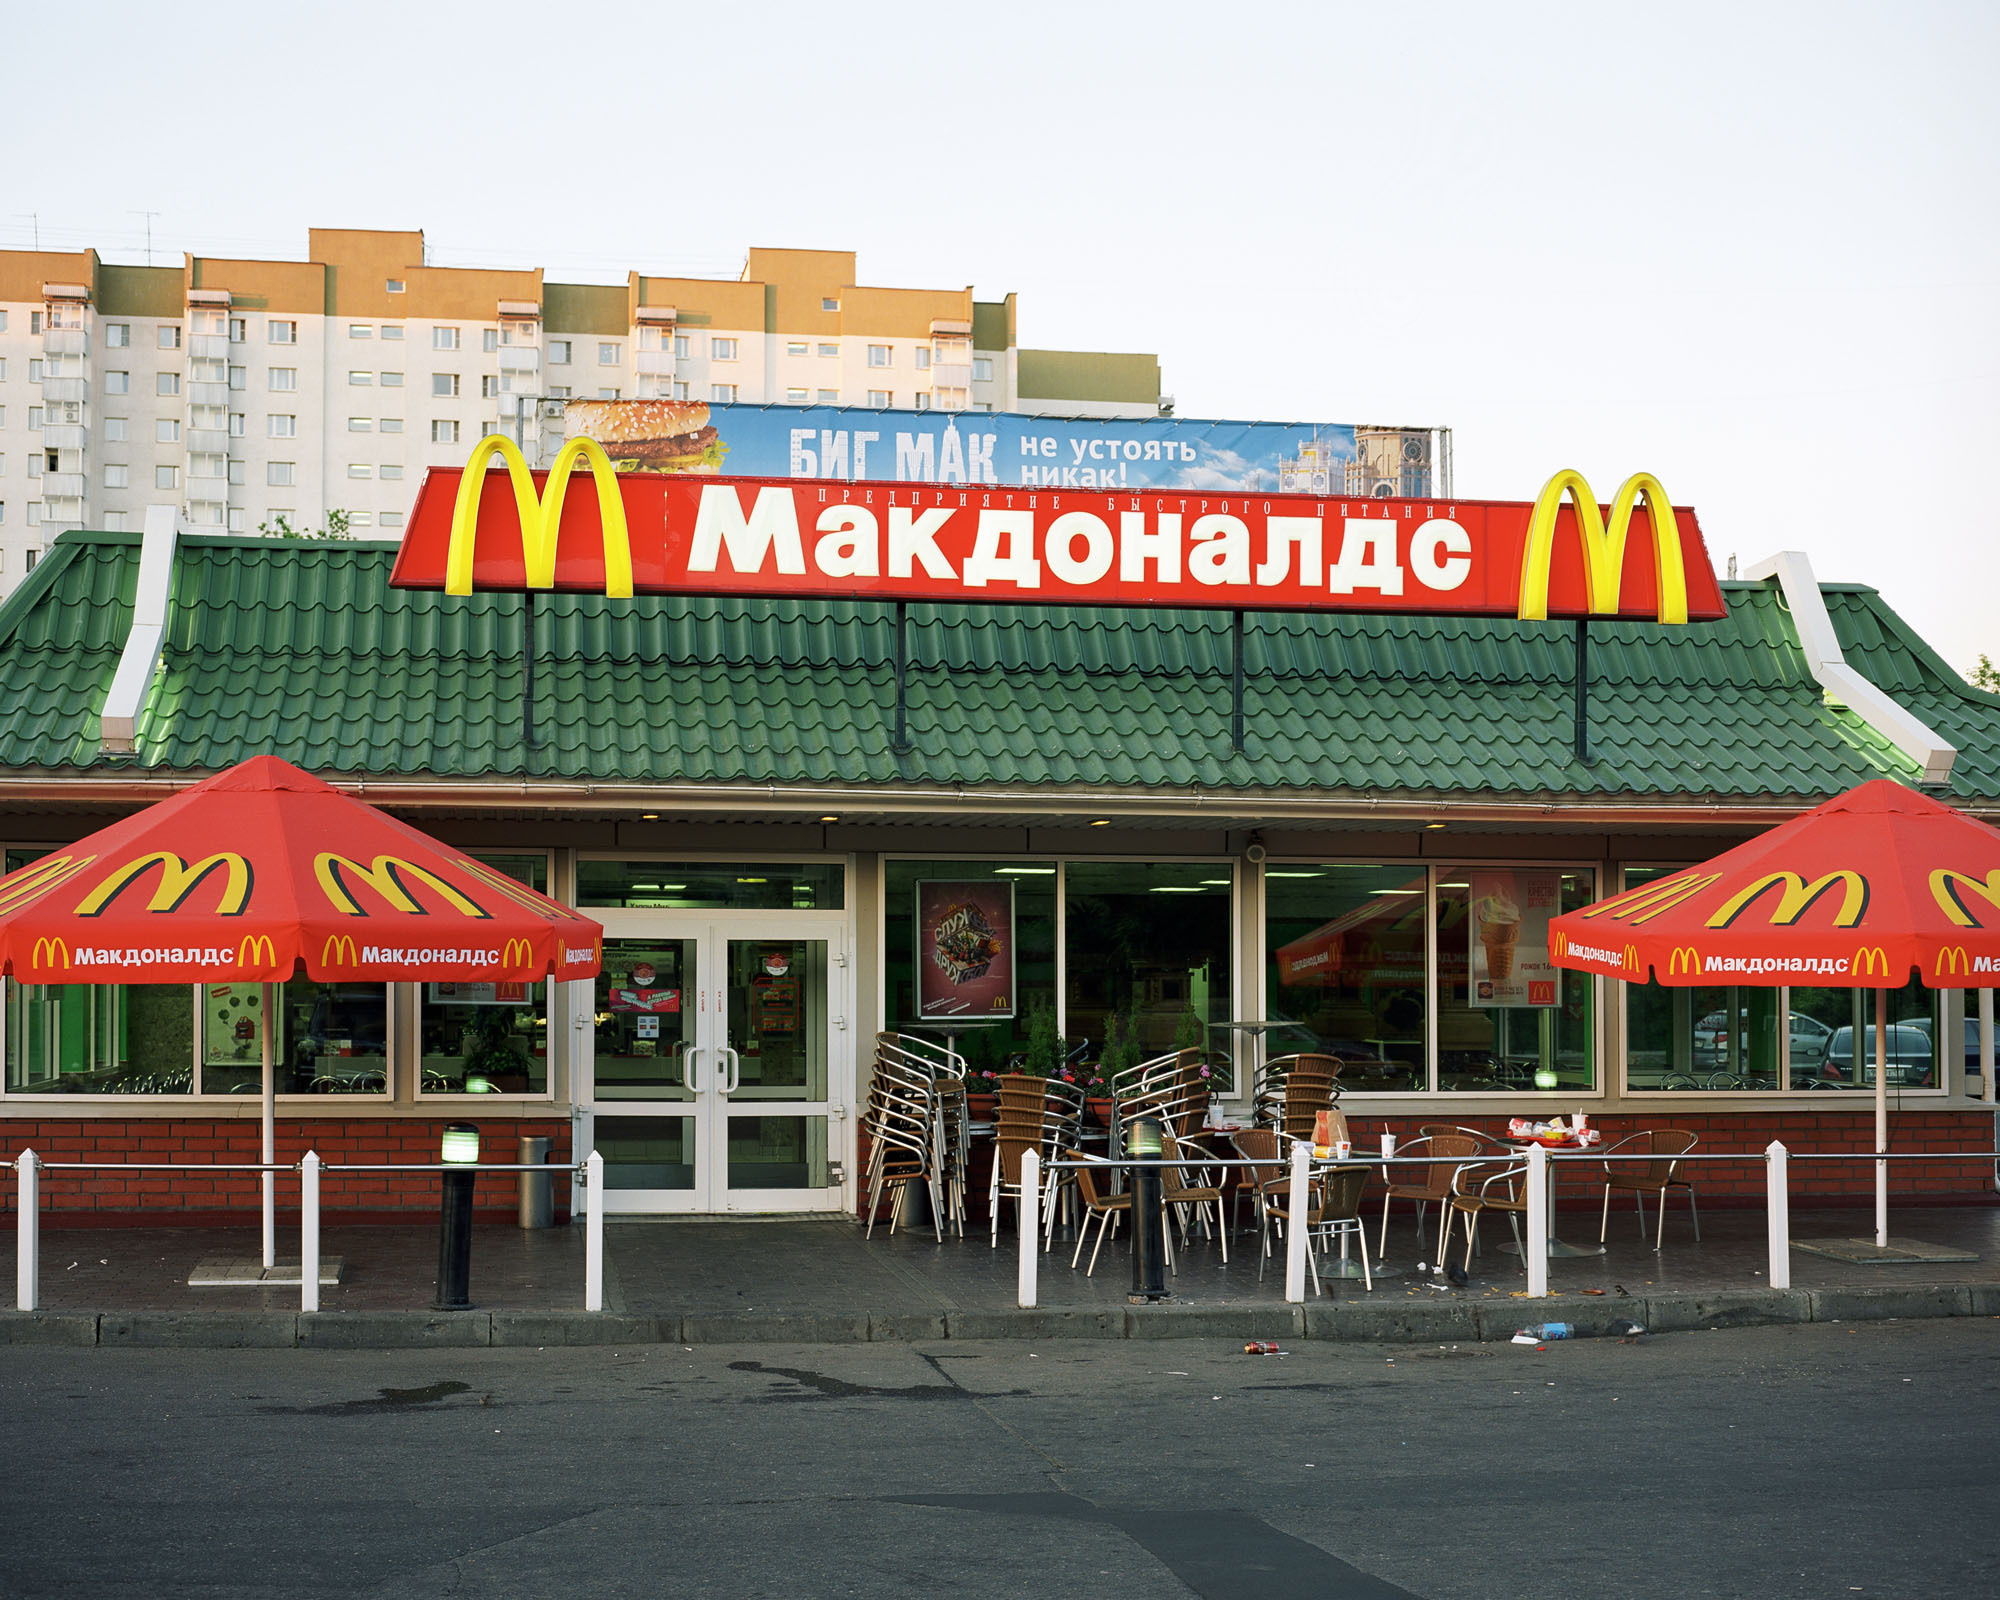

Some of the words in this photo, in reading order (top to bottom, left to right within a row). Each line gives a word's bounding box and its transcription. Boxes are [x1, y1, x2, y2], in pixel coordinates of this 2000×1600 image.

[791, 428, 879, 481] БИГ
[896, 416, 998, 484] МАК
[1020, 436, 1057, 457] не
[1070, 438, 1196, 465] устоять
[1021, 462, 1127, 488] никак!
[818, 488, 1060, 511] ПРЕДПРИЯТИЕ
[1107, 498, 1271, 515] БЫСТРОГО
[1317, 504, 1456, 520] ПИТАНИЯ
[687, 484, 1472, 596] Макдоналдс
[75, 948, 234, 967] Макдоналдс
[362, 946, 499, 966] Макдоналдс
[1567, 941, 1623, 967] Макдоналдс
[1704, 956, 1849, 974] Макдоналдс
